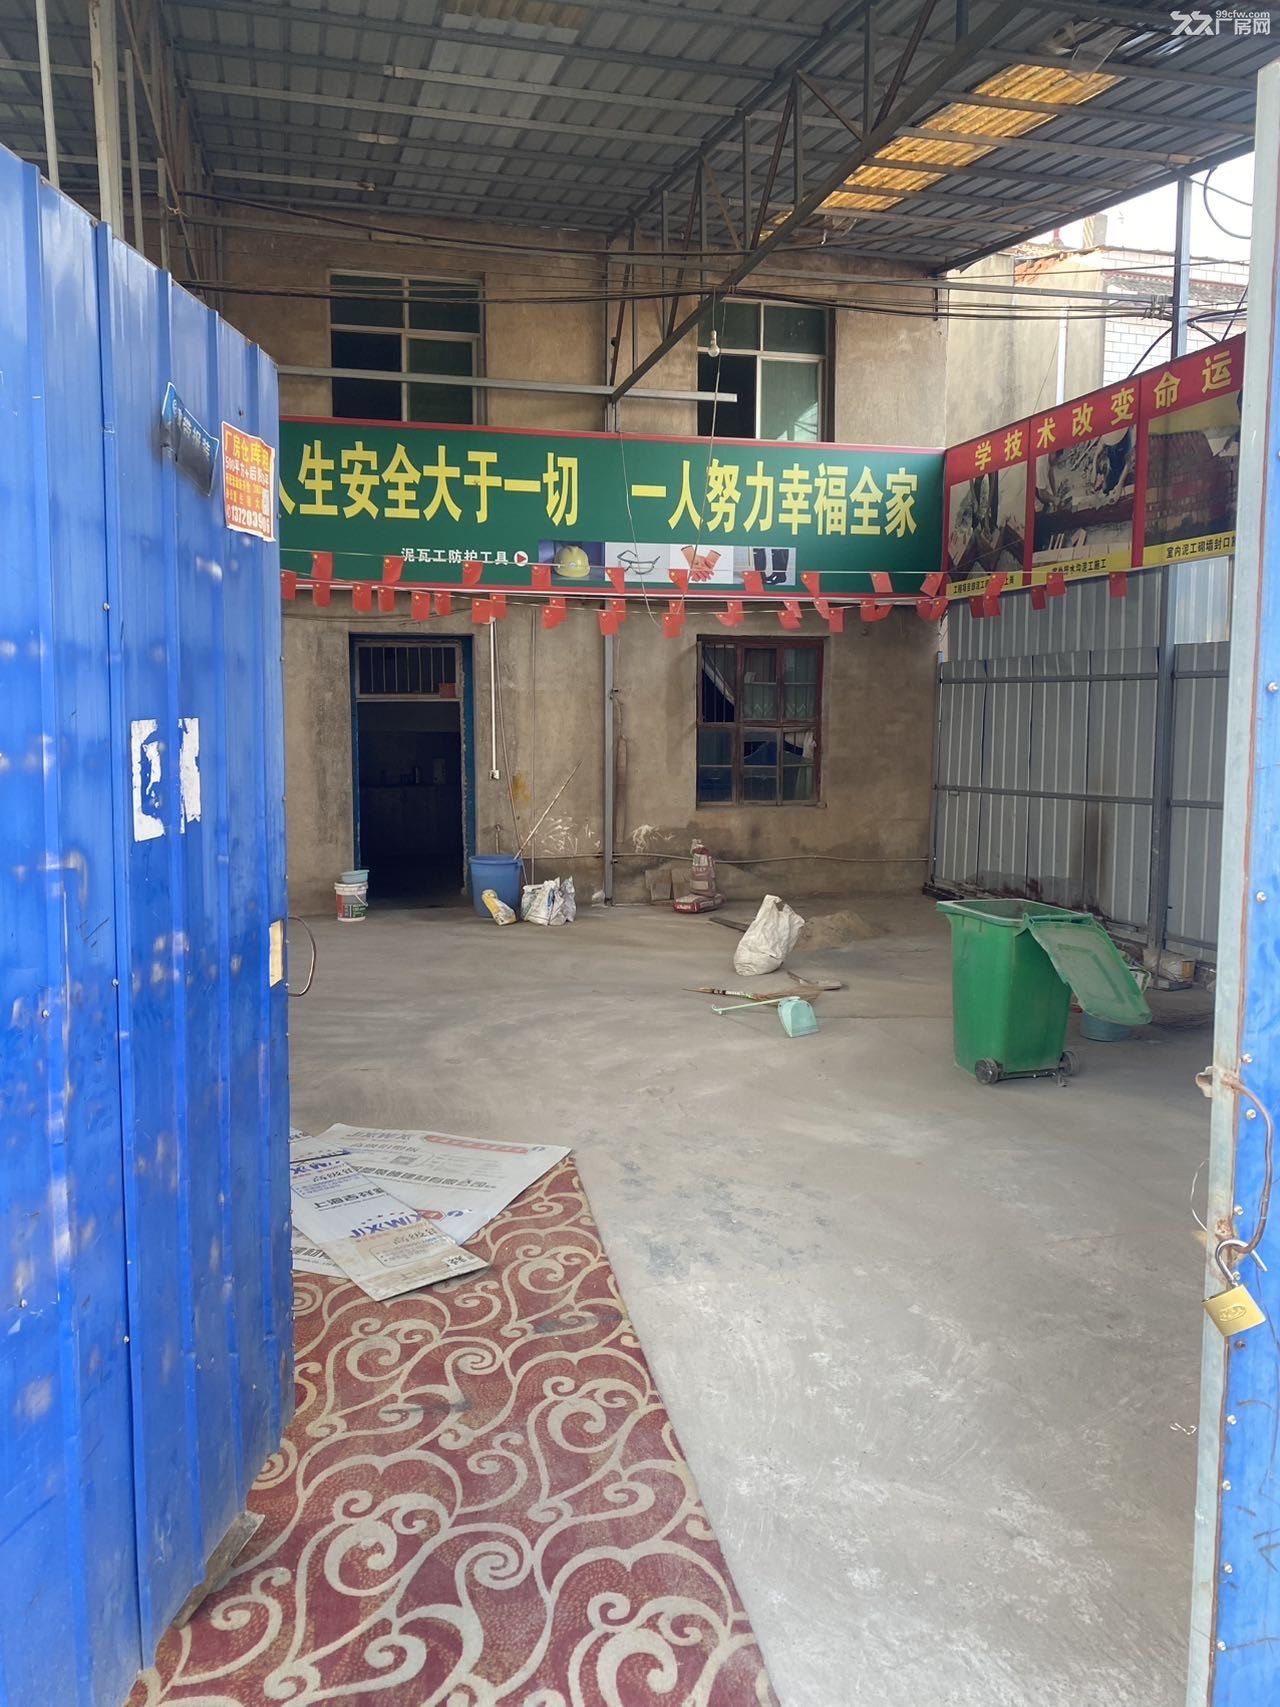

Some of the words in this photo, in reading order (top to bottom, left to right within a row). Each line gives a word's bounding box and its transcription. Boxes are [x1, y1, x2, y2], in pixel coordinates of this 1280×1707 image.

[974, 350, 1233, 471] 学技术改变命运
[631, 458, 918, 538] 一人努力幸福全家
[401, 547, 509, 566] 泥瓦工防护工具
